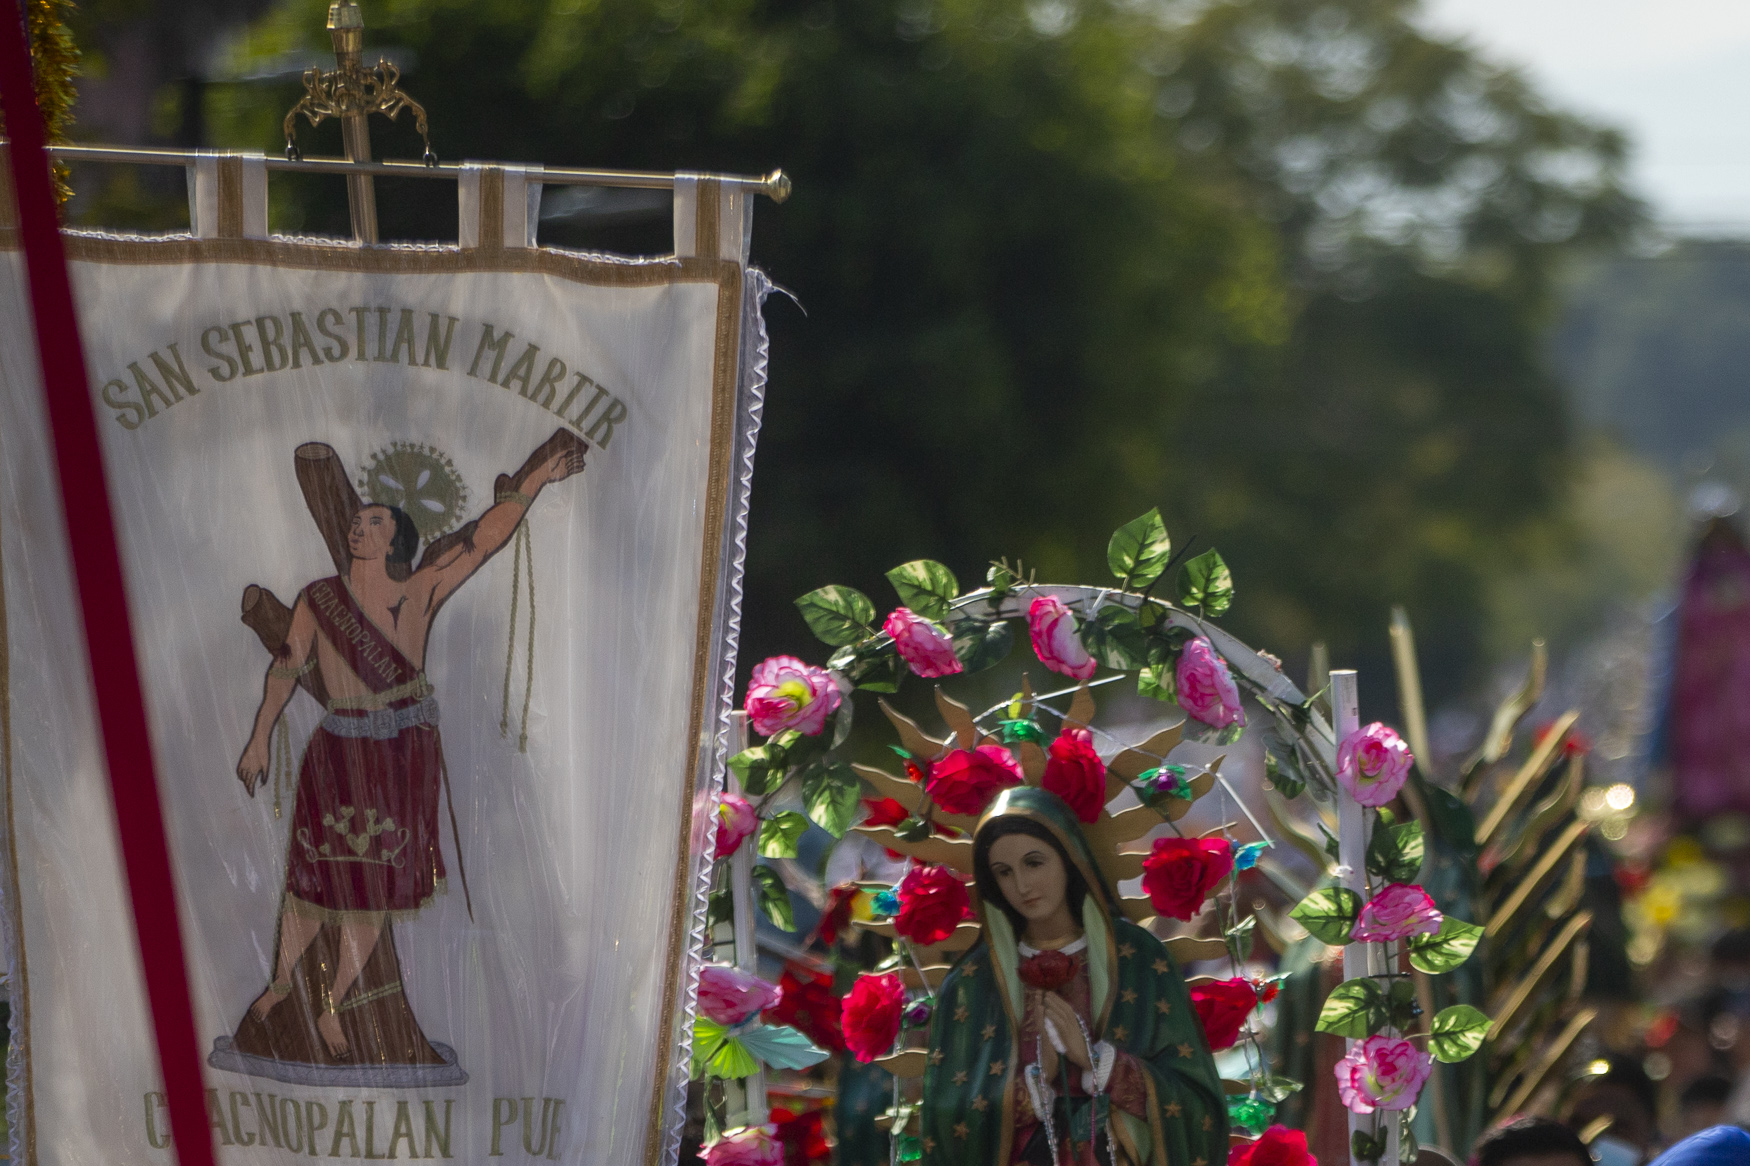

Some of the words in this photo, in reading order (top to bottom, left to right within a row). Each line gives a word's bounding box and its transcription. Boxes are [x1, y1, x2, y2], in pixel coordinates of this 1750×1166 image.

[102, 343, 200, 430] SAN
[200, 307, 459, 382] SEBASTIAN
[467, 323, 627, 450] MARTIR
[144, 1089, 455, 1160] CACNOPALAN
